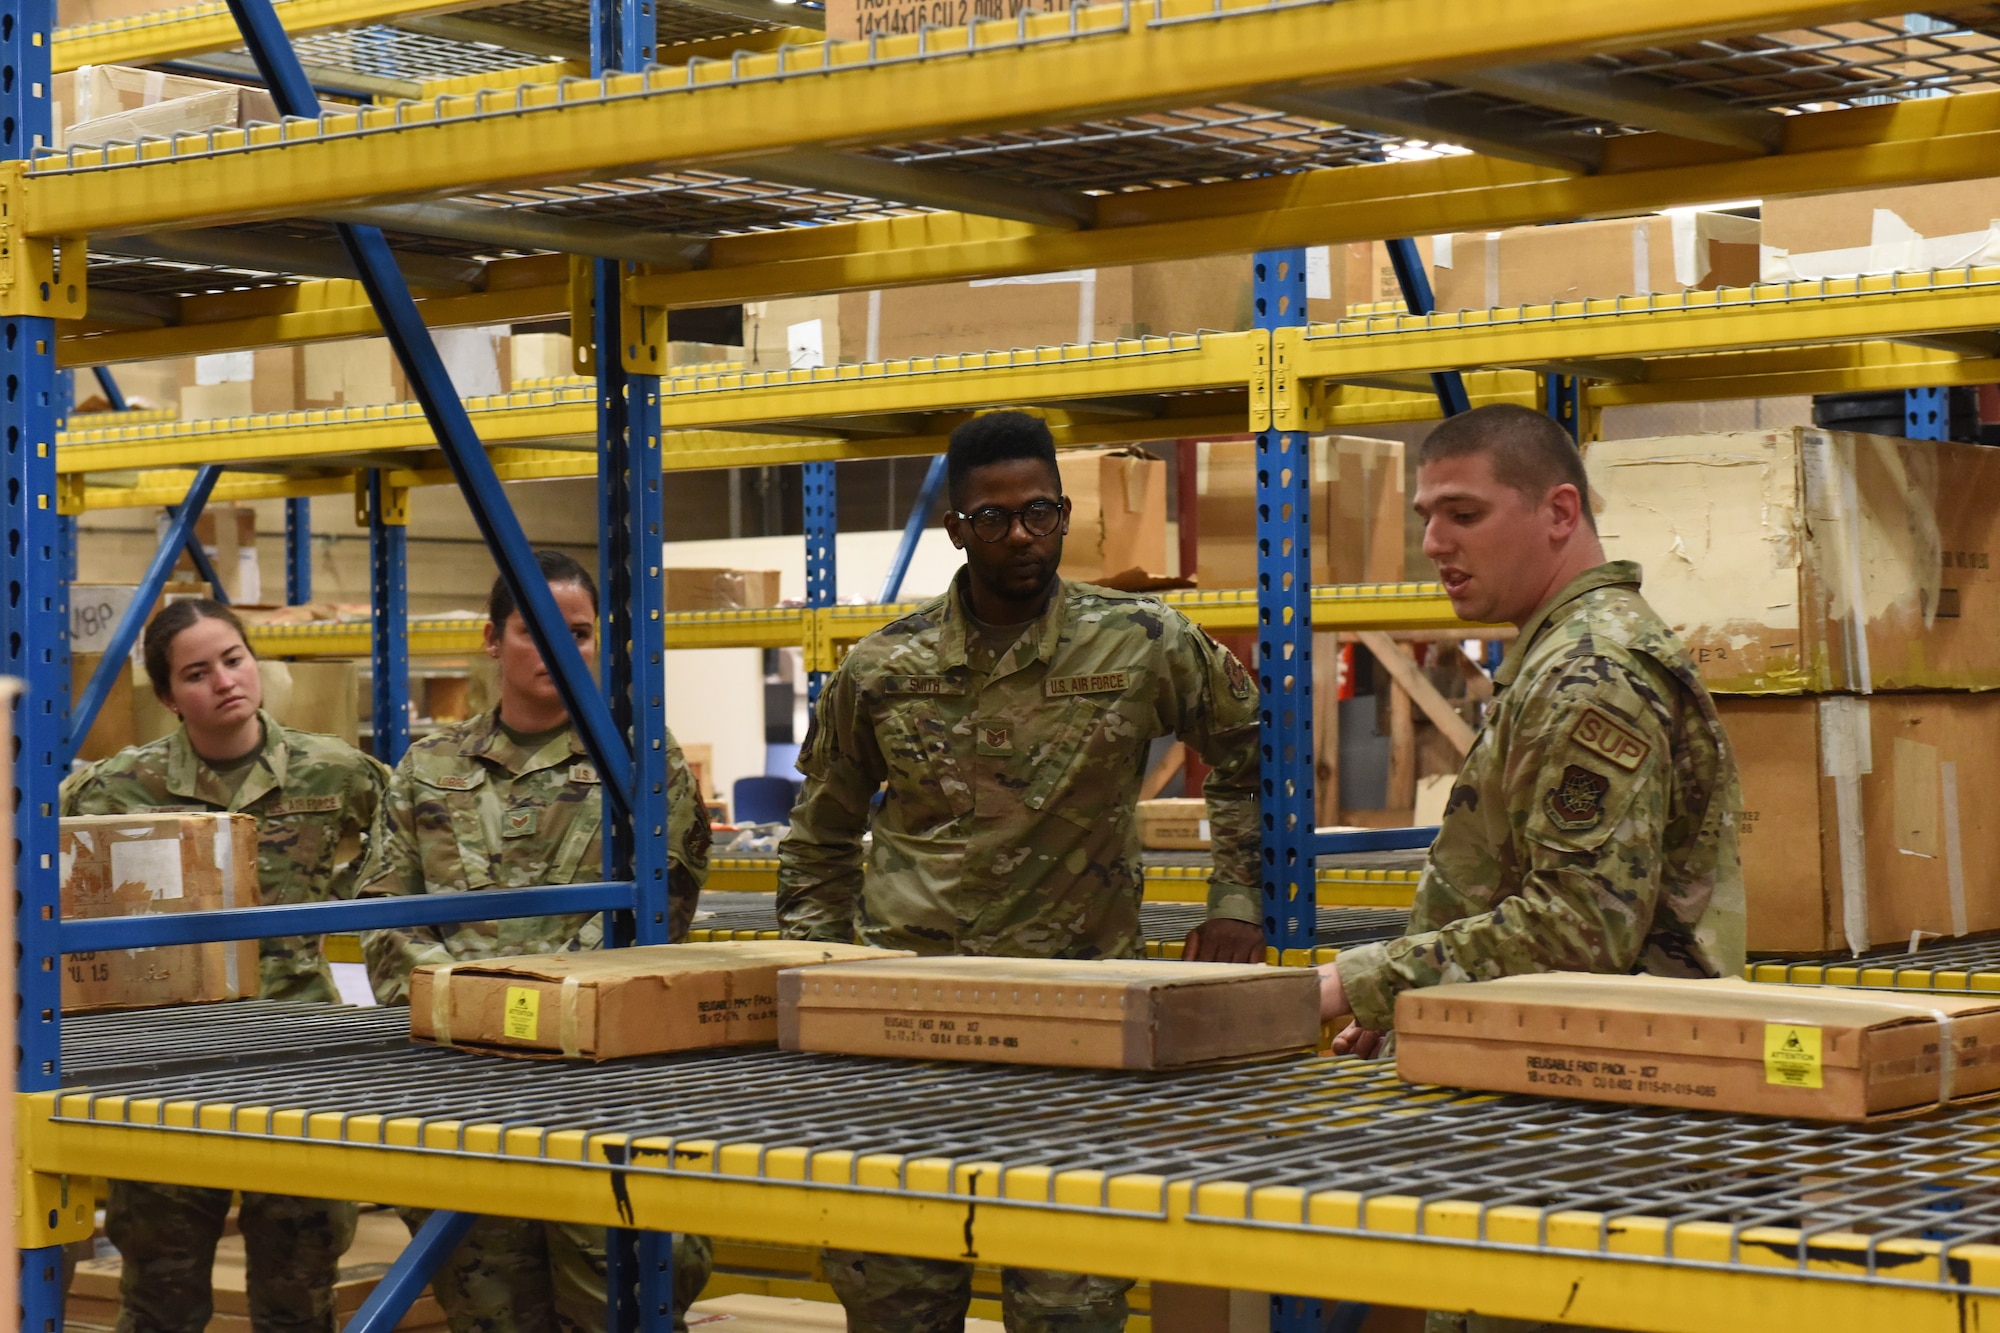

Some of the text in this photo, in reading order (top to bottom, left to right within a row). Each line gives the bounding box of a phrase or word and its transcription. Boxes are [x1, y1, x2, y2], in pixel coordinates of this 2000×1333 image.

[909, 677, 940, 692] SMITH
[1051, 674, 1125, 694] U.S. AIR FORCE
[1578, 717, 1642, 760] SUP
[1526, 1055, 1575, 1072] REUSABLE
[1576, 1060, 1600, 1073] FAST
[1601, 1062, 1626, 1076] PACK
[1771, 1051, 1815, 1061] ATTENTION
